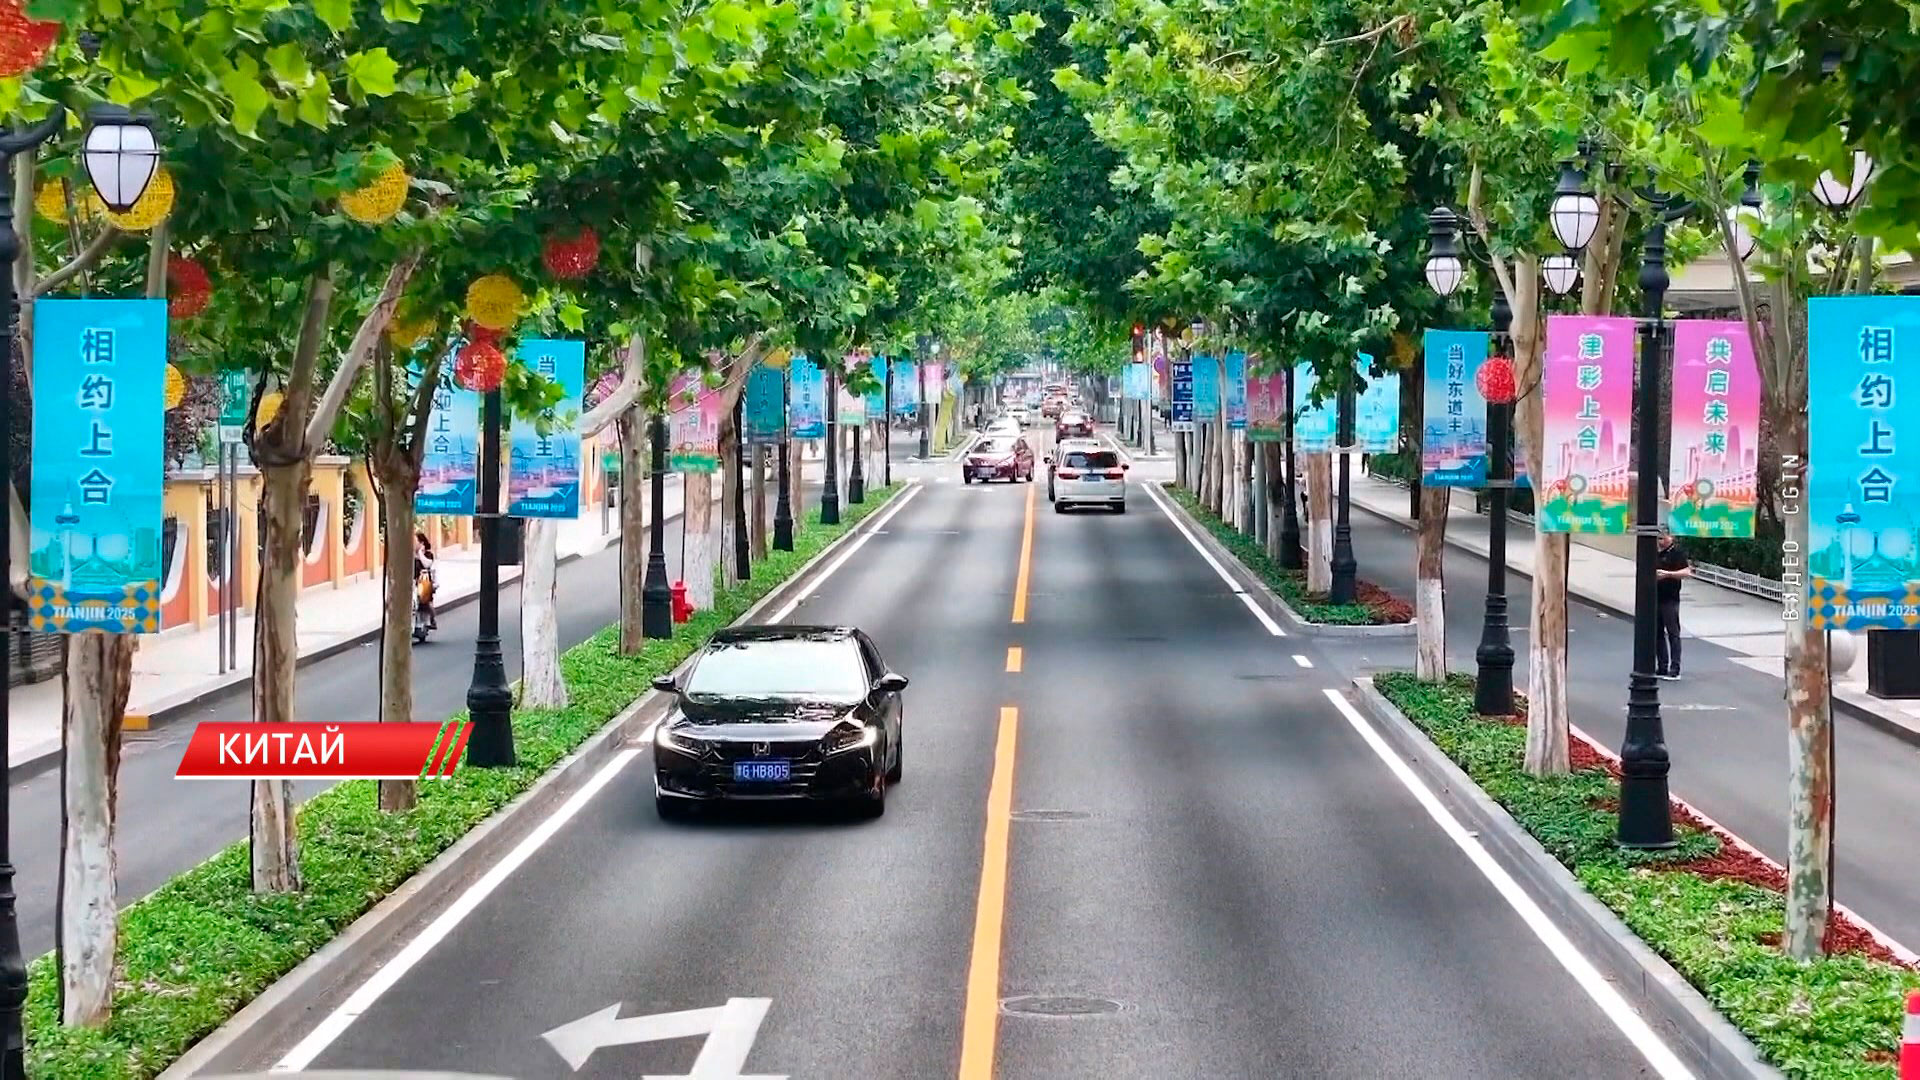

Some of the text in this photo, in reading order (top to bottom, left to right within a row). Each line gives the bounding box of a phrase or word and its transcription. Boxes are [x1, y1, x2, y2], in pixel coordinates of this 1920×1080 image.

[80, 328, 115, 504] 相约上合
[1447, 344, 1464, 433] 当好东道主
[1577, 333, 1604, 450] 津彩上合
[1703, 337, 1732, 455] 共启未来
[1860, 328, 1894, 503] 相约上合
[53, 606, 136, 622] TIANJIN 2025
[1833, 604, 1918, 619] TIANJIN 2025
